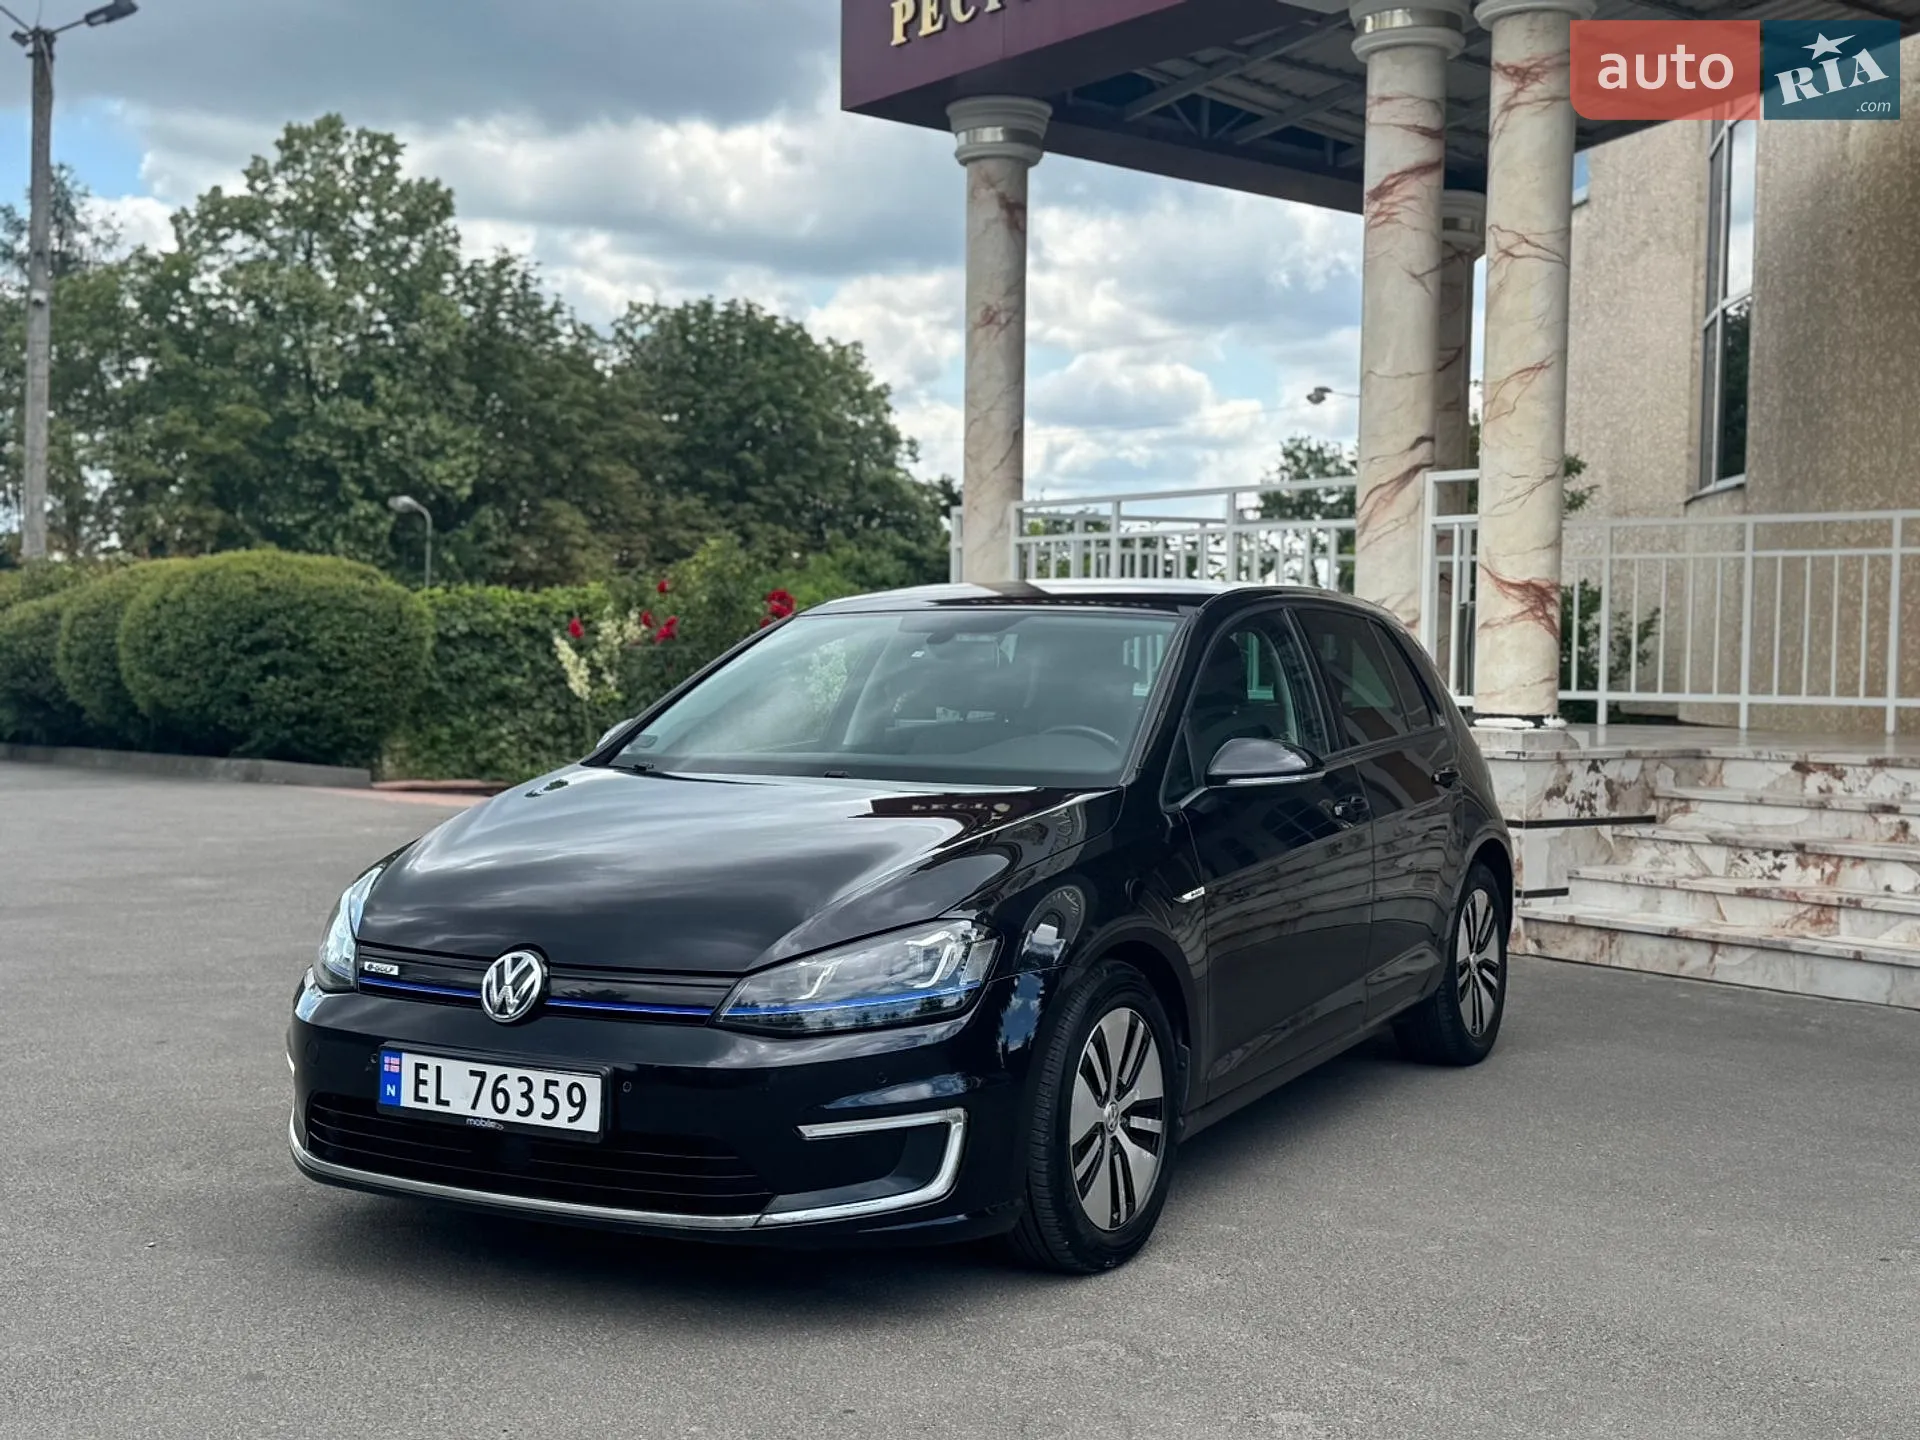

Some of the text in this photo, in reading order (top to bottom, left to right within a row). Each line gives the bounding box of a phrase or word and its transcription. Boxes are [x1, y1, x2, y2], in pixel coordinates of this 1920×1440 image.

[386, 1084, 396, 1097] N
[414, 1062, 587, 1123] EL 76359
